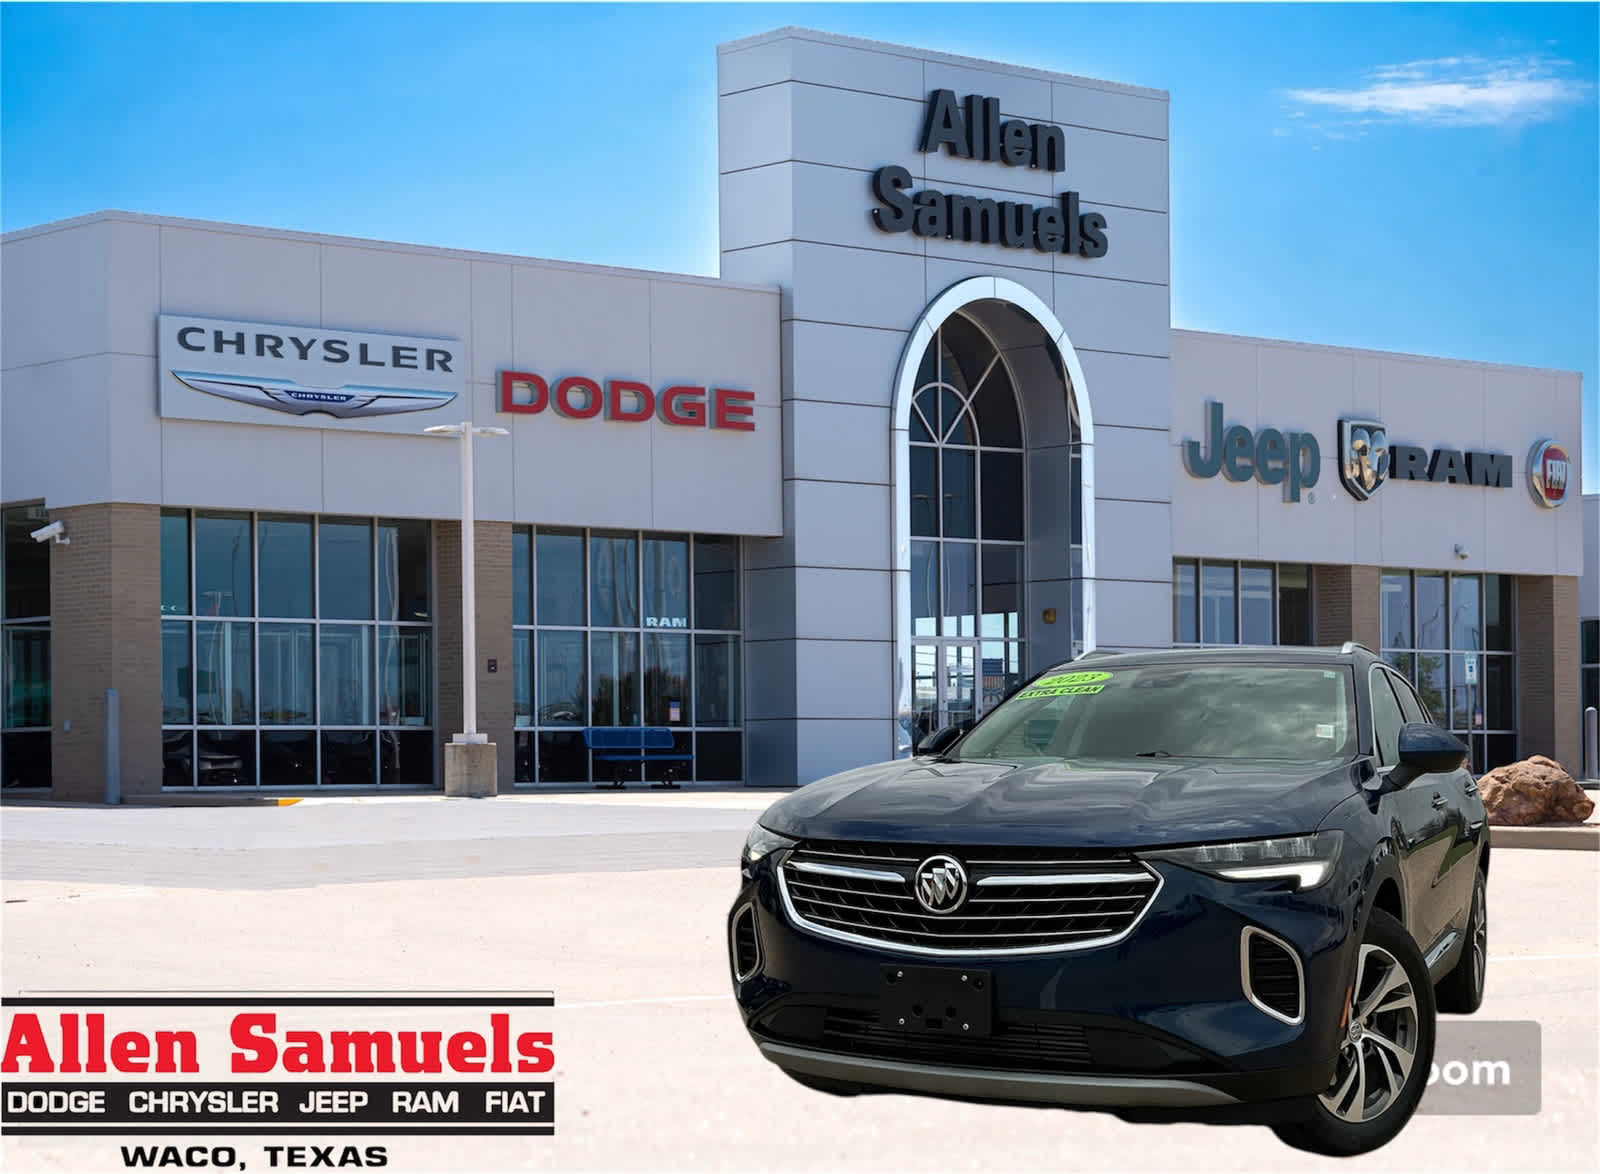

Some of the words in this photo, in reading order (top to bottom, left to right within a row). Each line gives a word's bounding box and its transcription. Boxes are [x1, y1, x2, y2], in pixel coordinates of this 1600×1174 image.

[918, 88, 1066, 172] Allen
[872, 165, 1109, 258] Samuels
[176, 326, 454, 373] CHRYSLER
[290, 391, 347, 401] CHRYSLER
[495, 370, 755, 432] DODGE
[1183, 400, 1321, 503] Jeep
[1388, 444, 1513, 488] RAM
[645, 616, 688, 627] RAM
